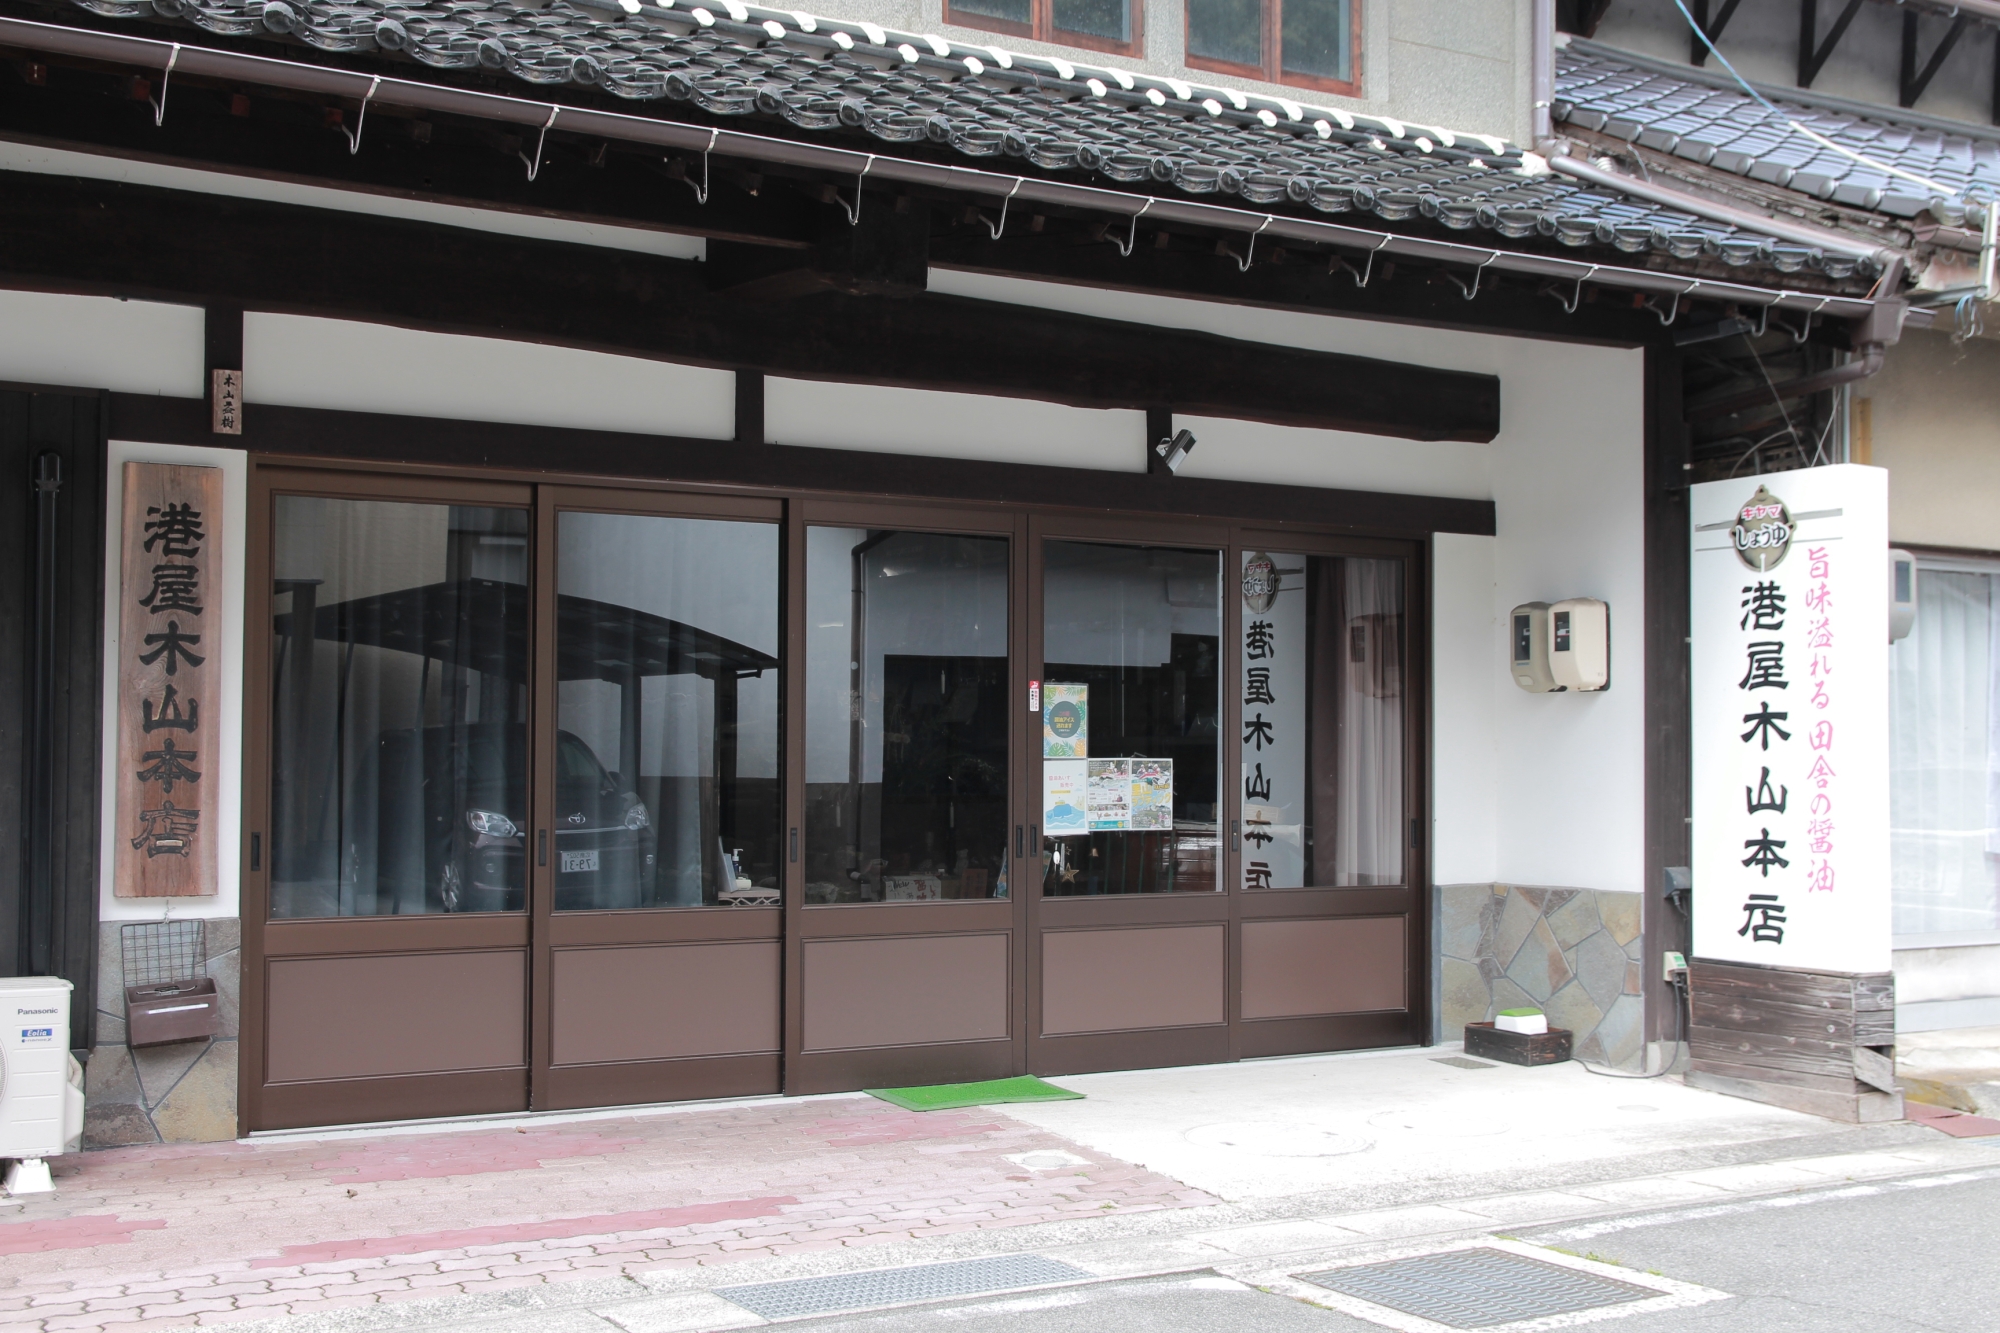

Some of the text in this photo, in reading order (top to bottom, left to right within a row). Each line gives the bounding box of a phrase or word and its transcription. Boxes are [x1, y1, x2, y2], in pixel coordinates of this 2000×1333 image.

[1736, 523, 1788, 549] しょうゆ
[1742, 505, 1781, 520] キヤマ
[131, 502, 206, 859] 港屋木山本店
[1737, 580, 1792, 945] 港屋木山本店
[1805, 546, 1836, 893] 旨味溢れる田舎の醤油
[17, 1007, 59, 1016] Panasonic
